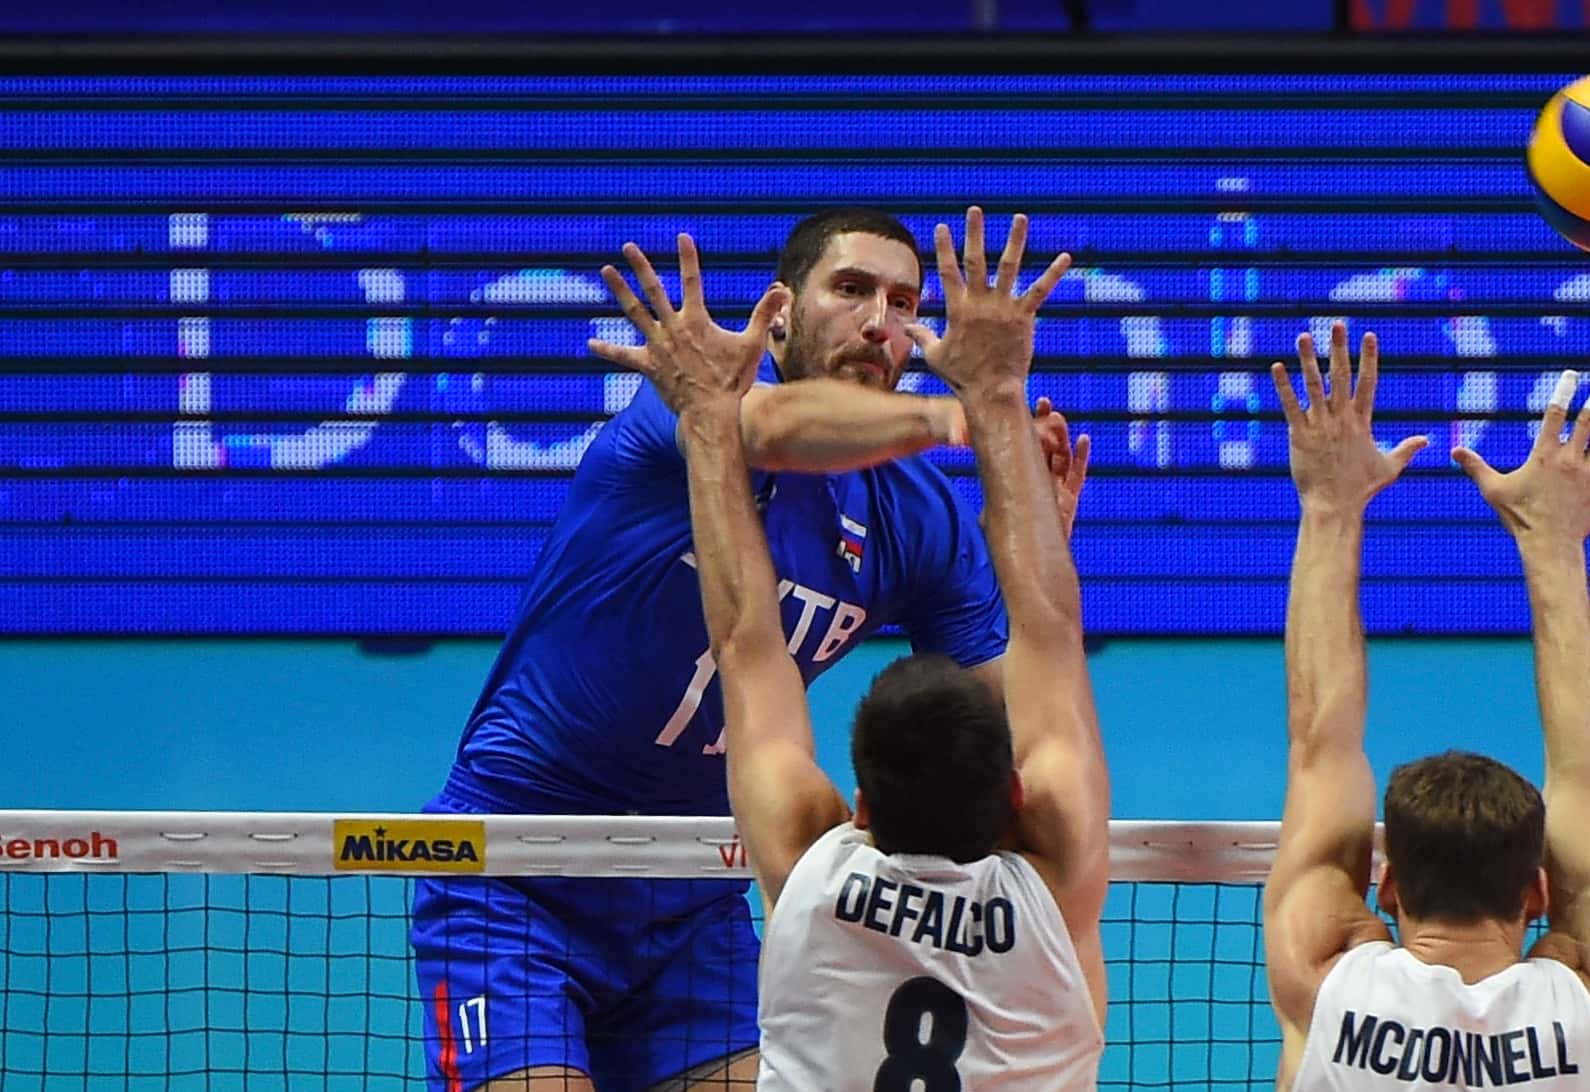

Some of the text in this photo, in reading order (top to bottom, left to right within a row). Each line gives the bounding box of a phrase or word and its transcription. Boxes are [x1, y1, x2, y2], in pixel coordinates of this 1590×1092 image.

[777, 578, 867, 662] TB
[0, 831, 118, 859] enoh
[835, 872, 1015, 957] DEFALCO
[459, 994, 487, 1053] 17
[1332, 1011, 1579, 1087] MCDONNELL
